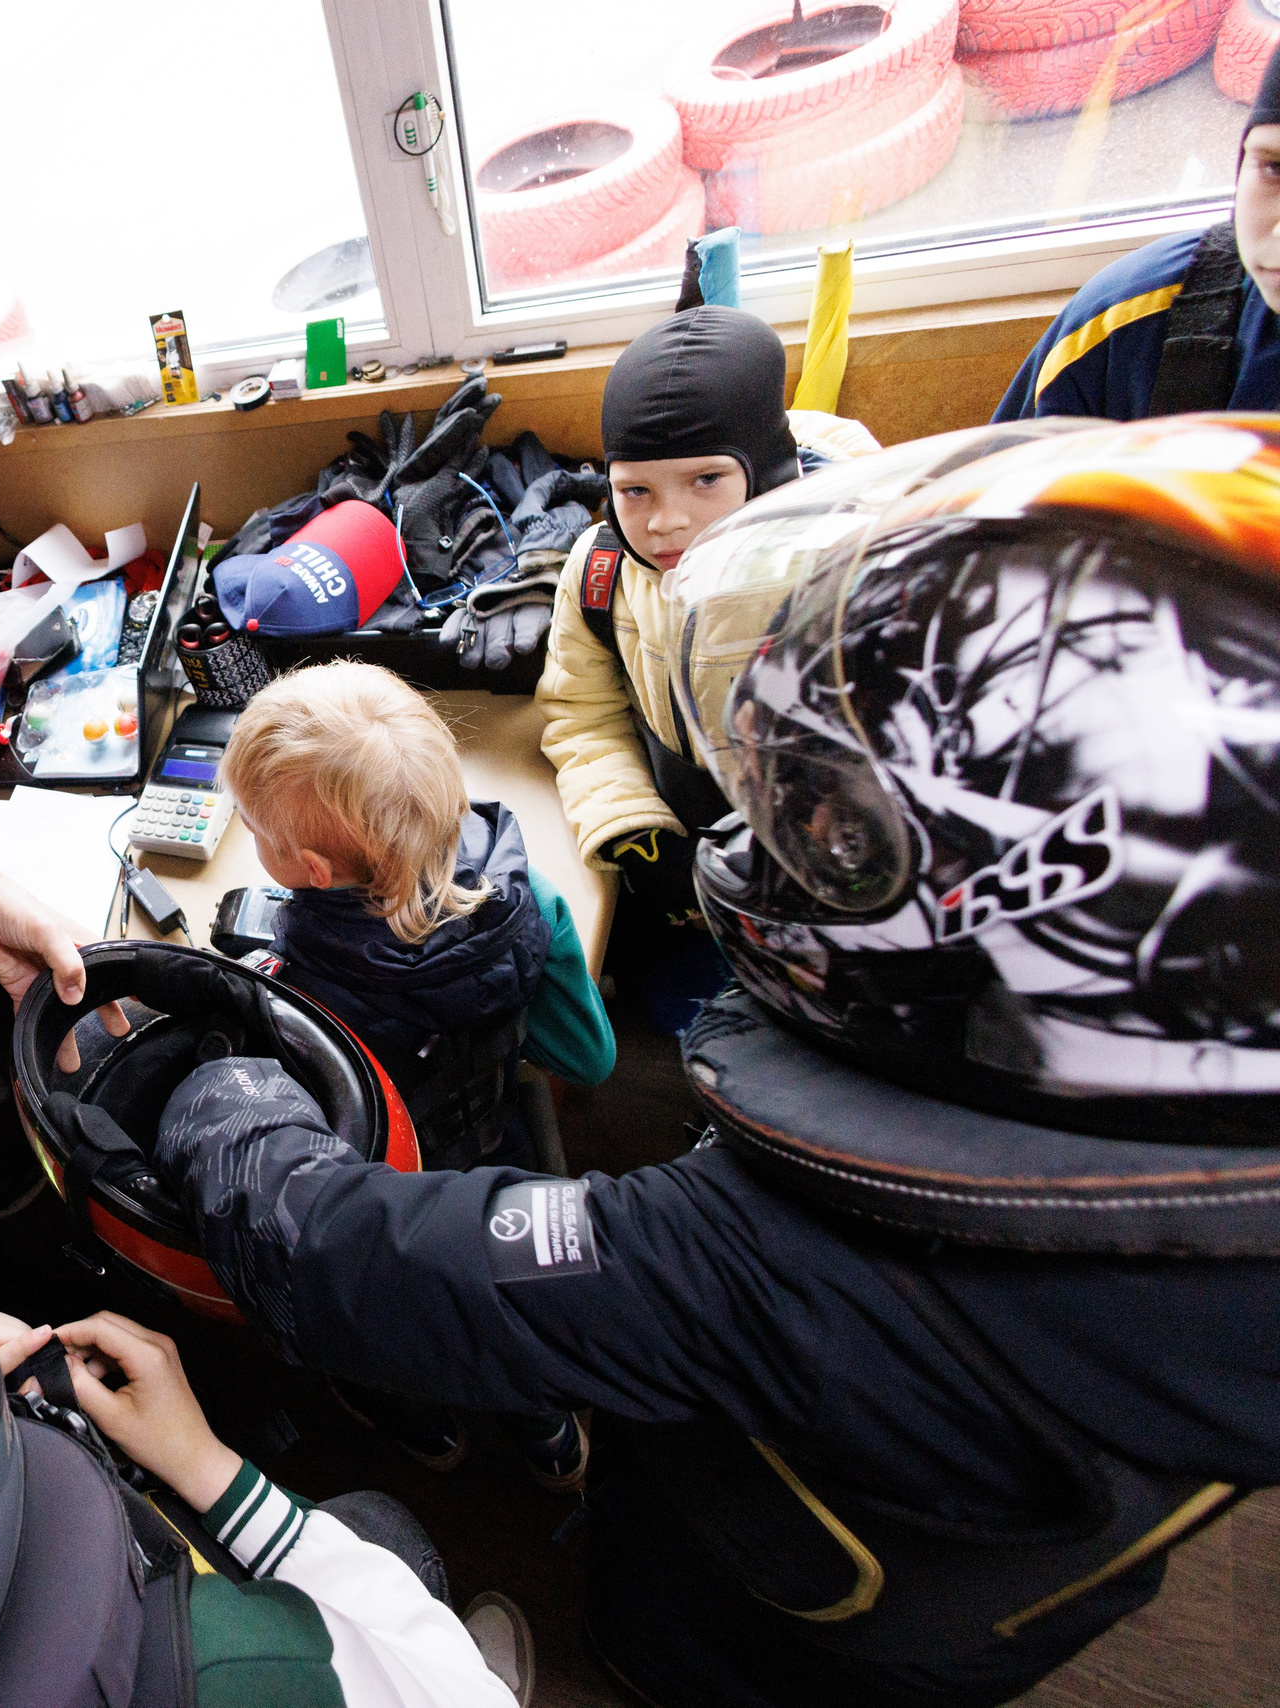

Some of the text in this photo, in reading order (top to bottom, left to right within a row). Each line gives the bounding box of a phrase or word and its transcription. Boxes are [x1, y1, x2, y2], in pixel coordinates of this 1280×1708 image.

[290, 544, 346, 596] CHILL
[290, 563, 329, 604] ALWAYS
[549, 1222, 564, 1264] APPAREL
[562, 1186, 582, 1262] GLISSADE
